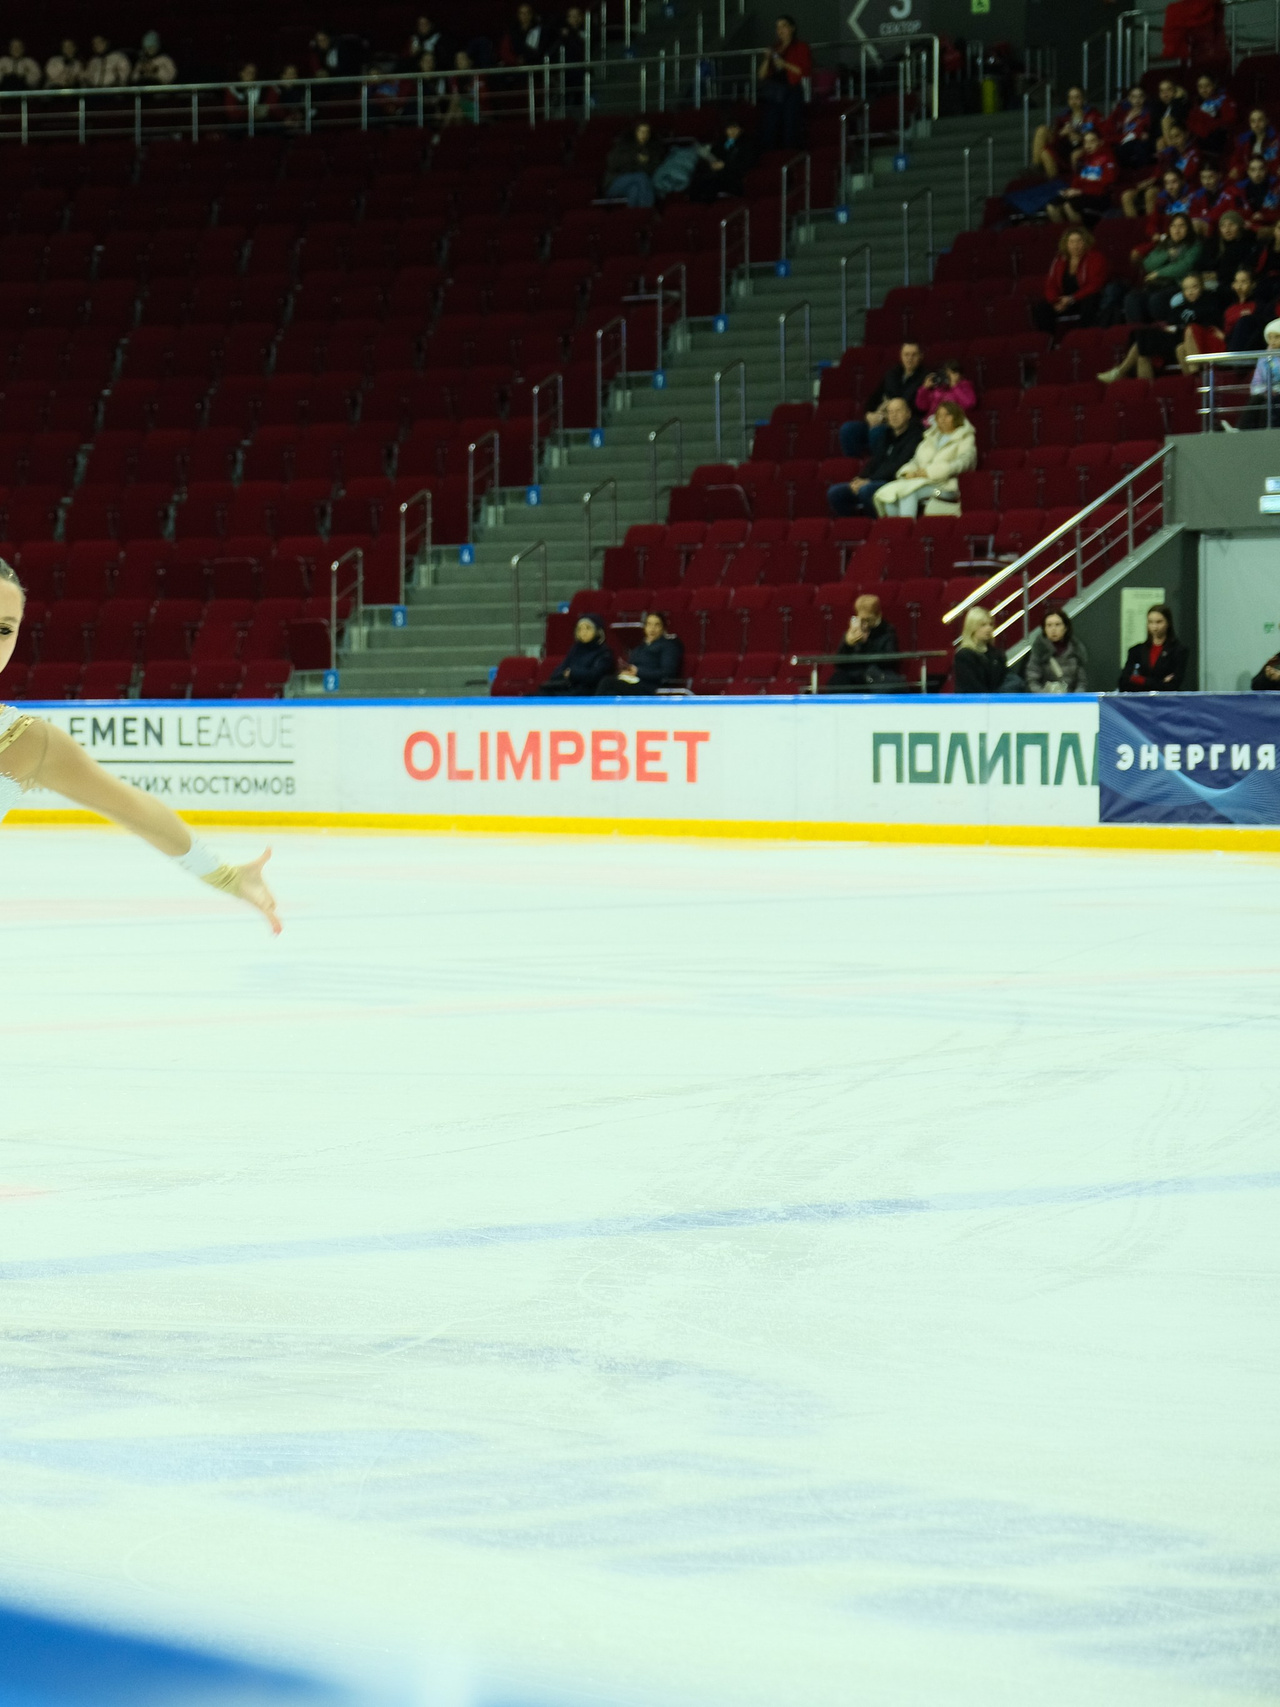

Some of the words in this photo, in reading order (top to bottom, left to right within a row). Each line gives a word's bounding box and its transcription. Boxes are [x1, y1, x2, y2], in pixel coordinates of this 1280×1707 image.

[47, 716, 164, 747] EMEN
[179, 715, 294, 748] LEAGUE
[403, 730, 710, 783] OLIMPBET
[872, 732, 1099, 786] ПОЛИПЛ
[1116, 743, 1277, 771] ЭНЕРГИЯ
[180, 775, 296, 797] КОСТЮМОВ
